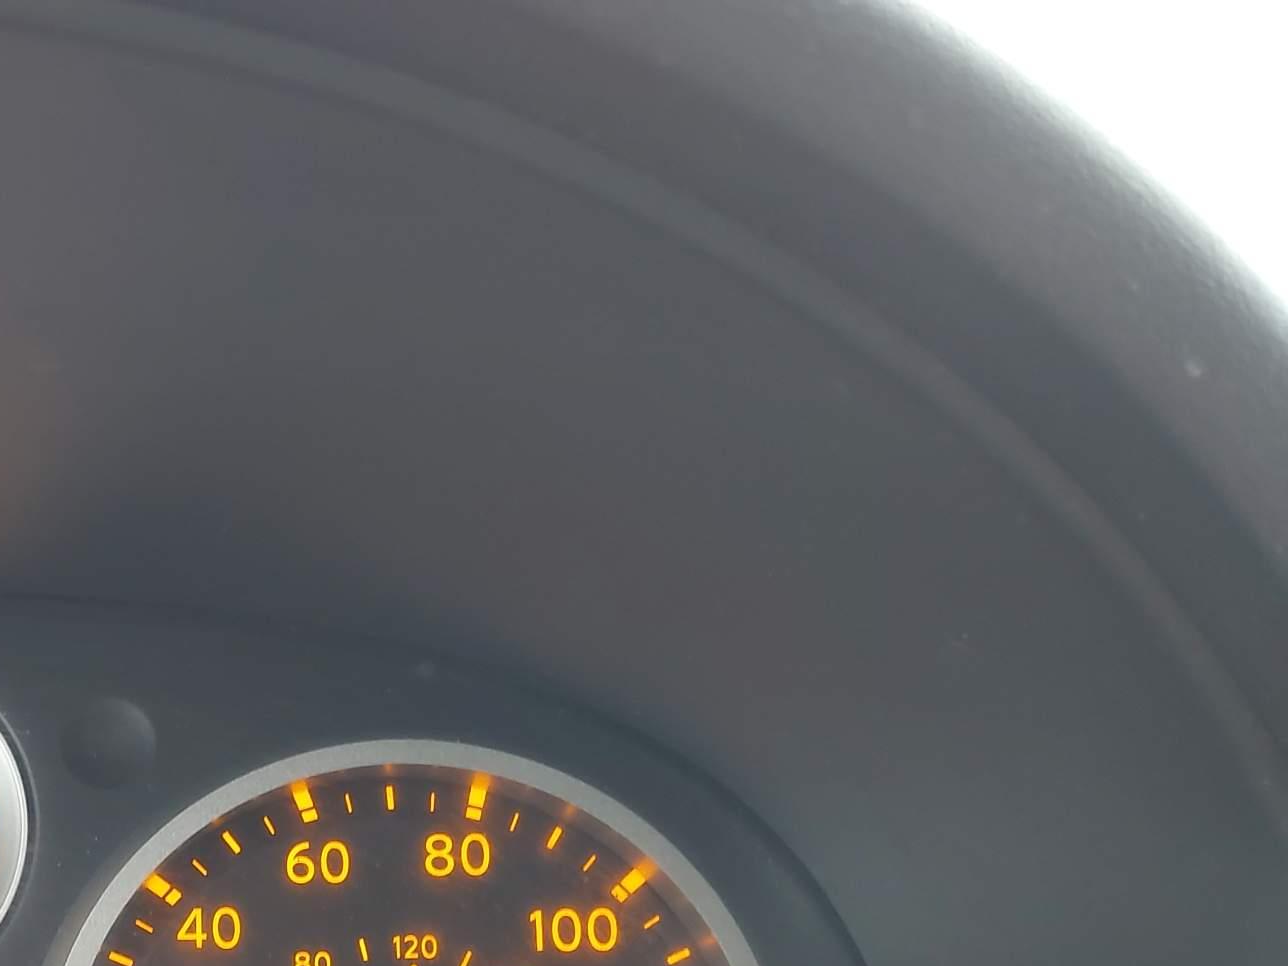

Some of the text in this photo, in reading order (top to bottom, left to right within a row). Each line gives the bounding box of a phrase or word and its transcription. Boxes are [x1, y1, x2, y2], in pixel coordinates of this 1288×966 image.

[285, 840, 351, 884] 60
[423, 833, 492, 878] 80
[176, 905, 242, 950] 40
[391, 934, 439, 961] 120
[528, 907, 619, 953] 100
